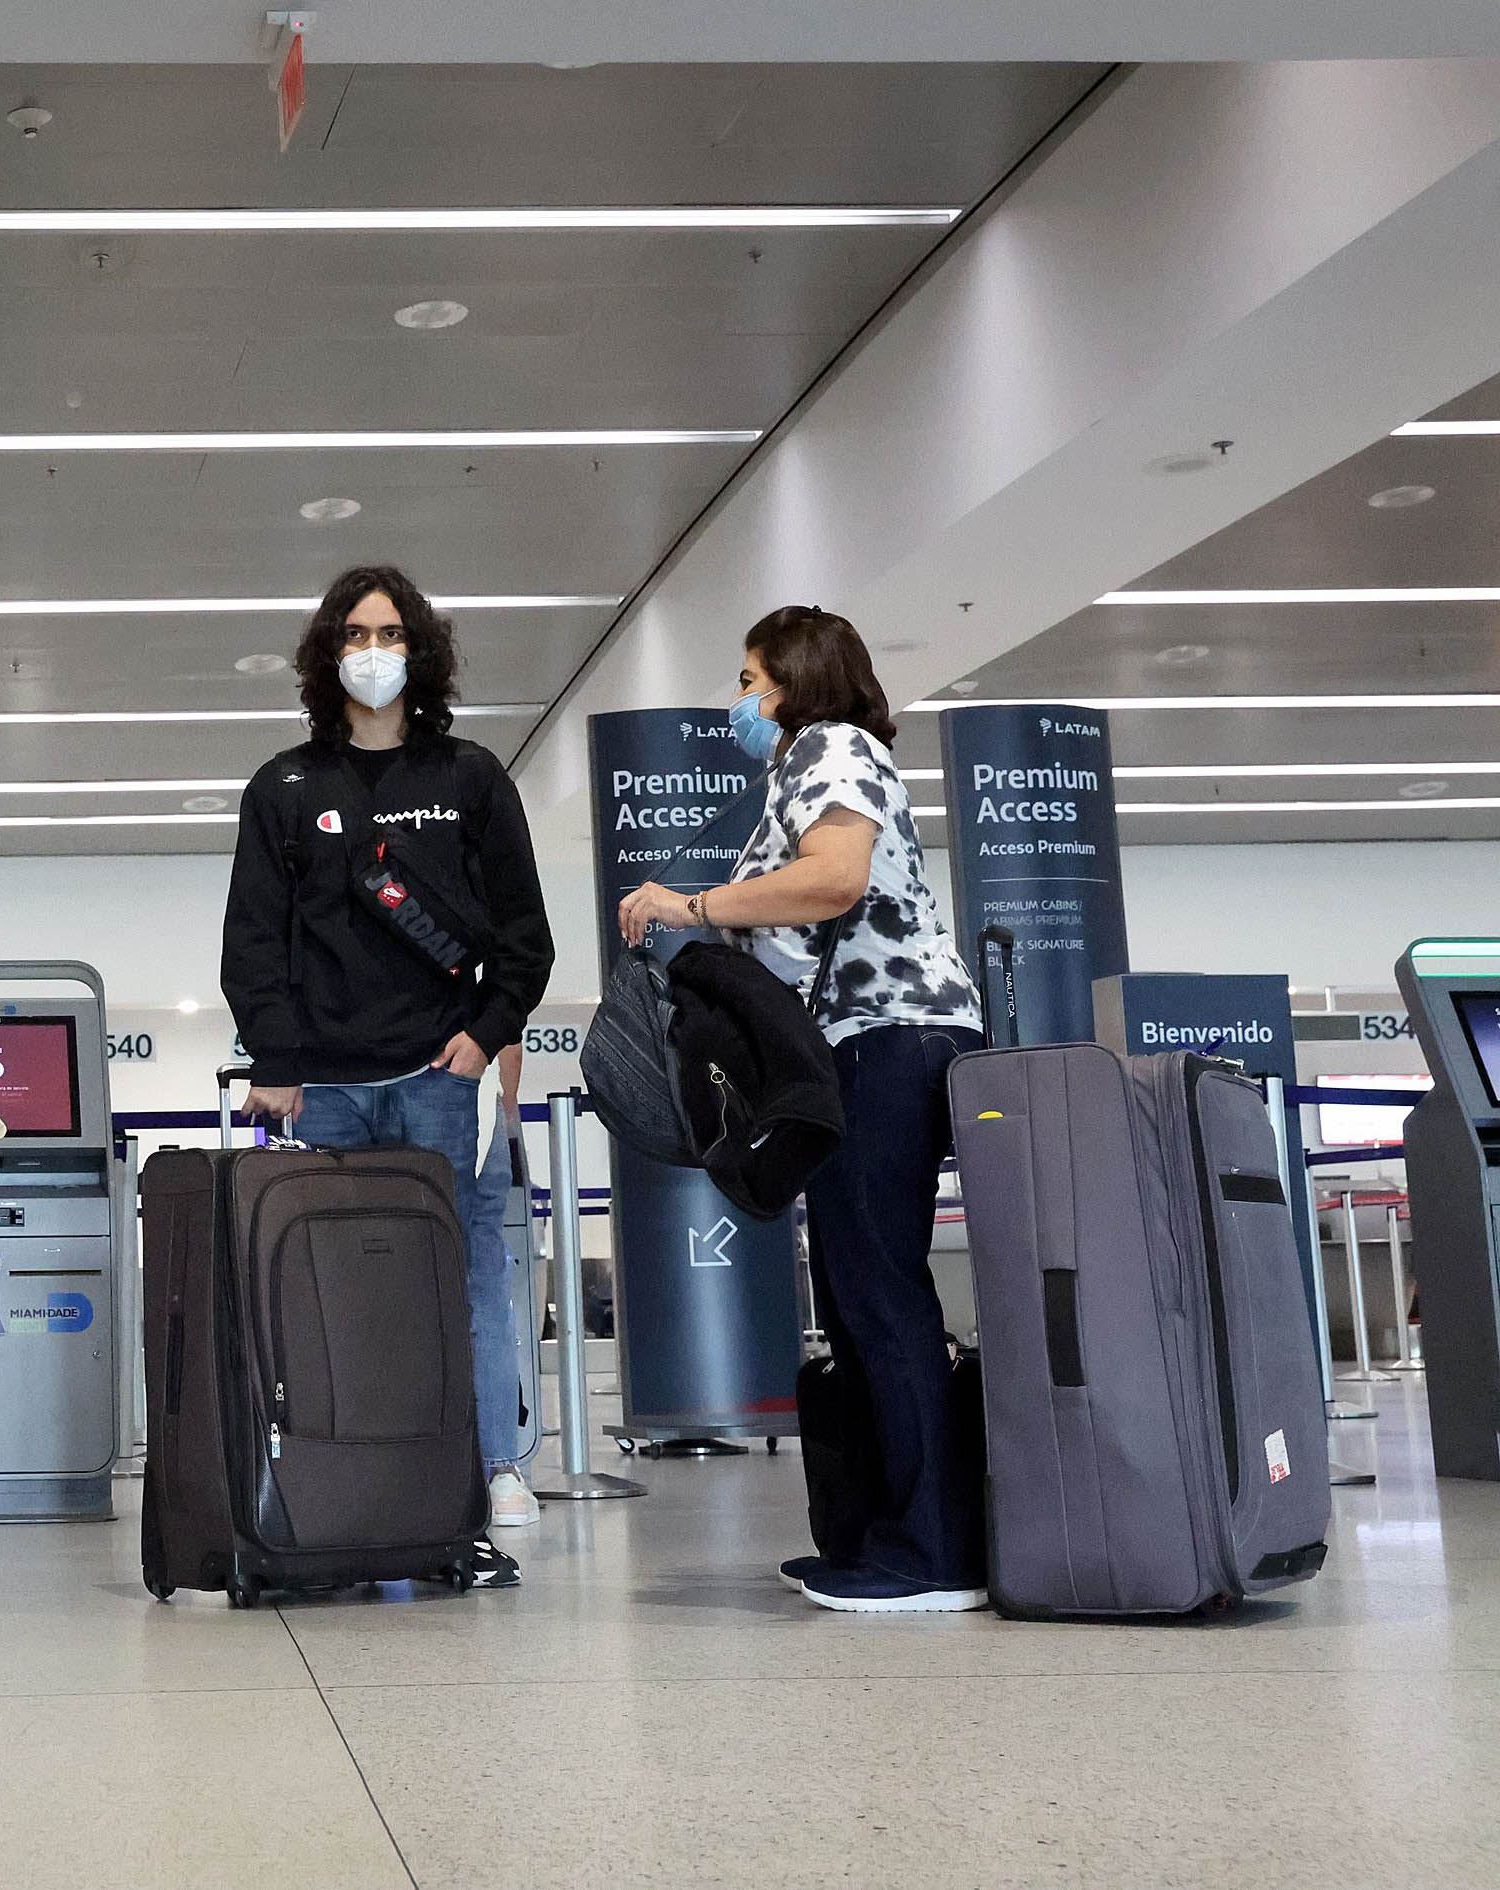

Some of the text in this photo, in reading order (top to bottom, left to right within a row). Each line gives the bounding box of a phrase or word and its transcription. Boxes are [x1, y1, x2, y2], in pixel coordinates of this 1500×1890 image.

[696, 726, 738, 739] LATA
[1055, 722, 1101, 738] LATAM
[612, 766, 747, 798] Premium
[973, 761, 1098, 792] Premium
[976, 796, 1078, 824] Access
[617, 848, 672, 864] Acceso
[979, 839, 1096, 857] Acceso Premium
[983, 900, 1039, 912] PREMIUM
[364, 872, 468, 968] JRDAN
[986, 939, 1085, 952] BLK SIGNATURE
[987, 955, 1026, 967] BLCK
[1005, 972, 1016, 1018] NAUTICA
[1141, 1020, 1273, 1044] Bienvenido
[1363, 1015, 1416, 1040] 534
[107, 1033, 153, 1059] 540
[525, 1028, 578, 1053] 538
